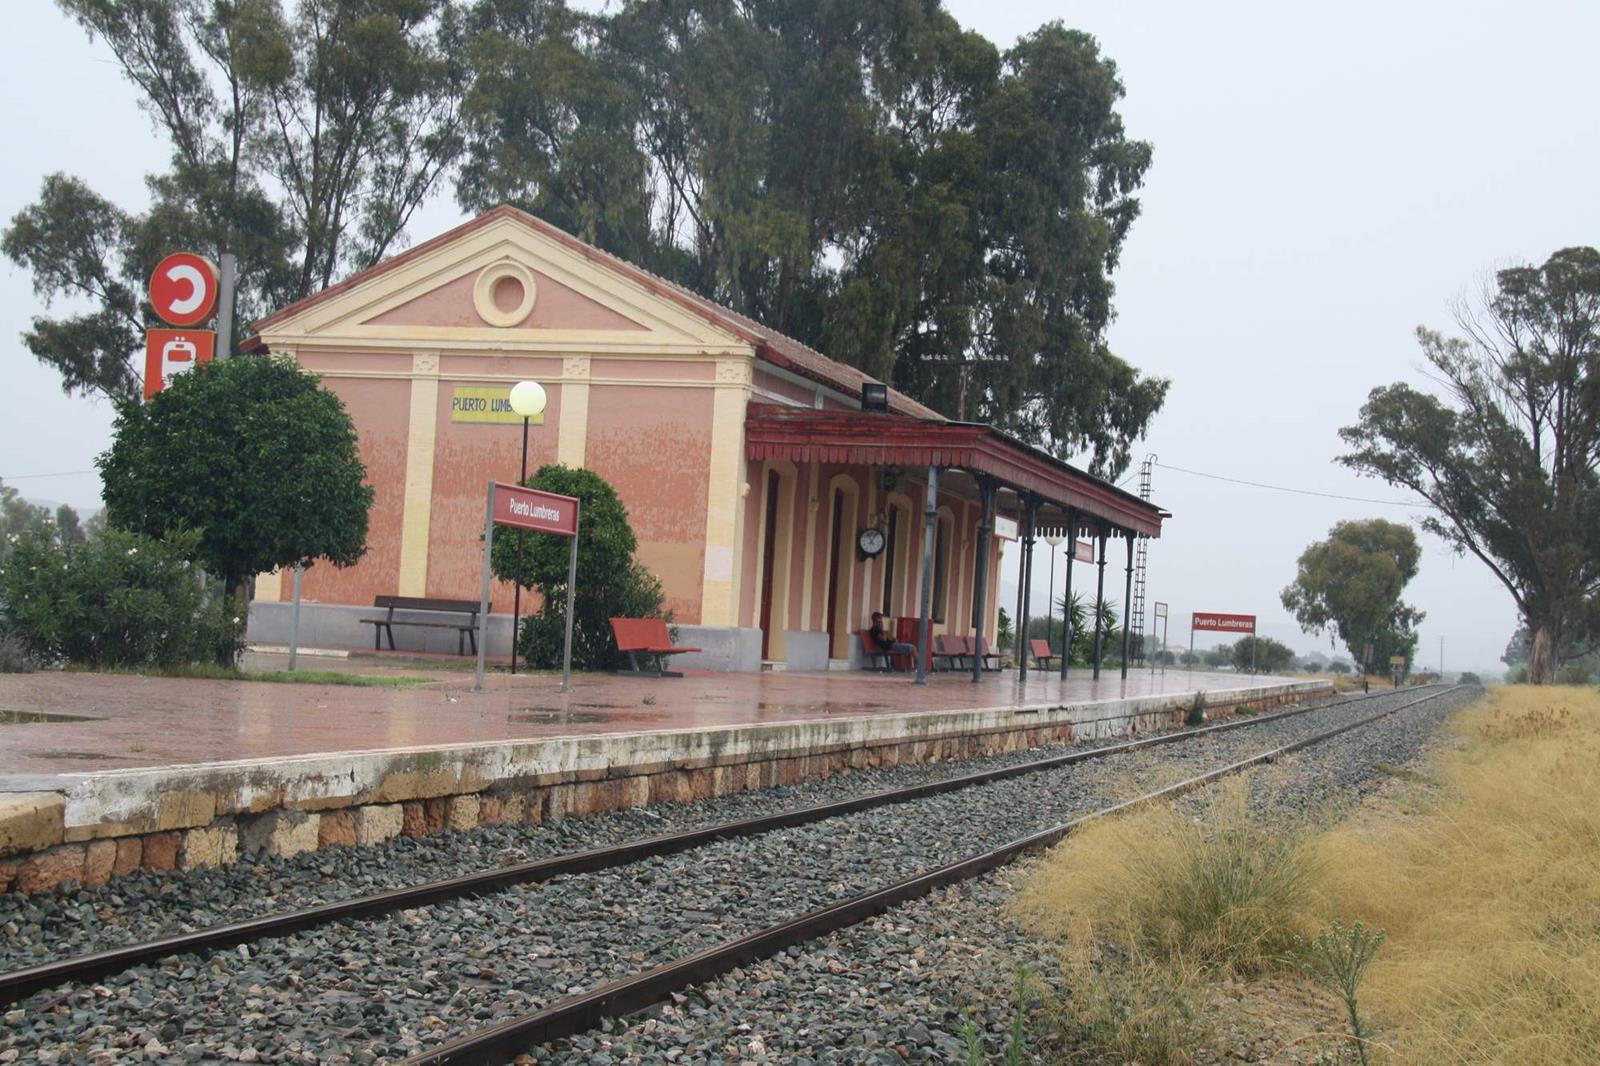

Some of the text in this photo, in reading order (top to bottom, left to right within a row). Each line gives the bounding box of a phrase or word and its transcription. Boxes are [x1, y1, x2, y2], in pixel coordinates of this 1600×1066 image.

[452, 397, 487, 412] PUERTO
[510, 498, 560, 522] Puerto Lumbreras
[1195, 617, 1253, 628] Puerto Lumbreras
